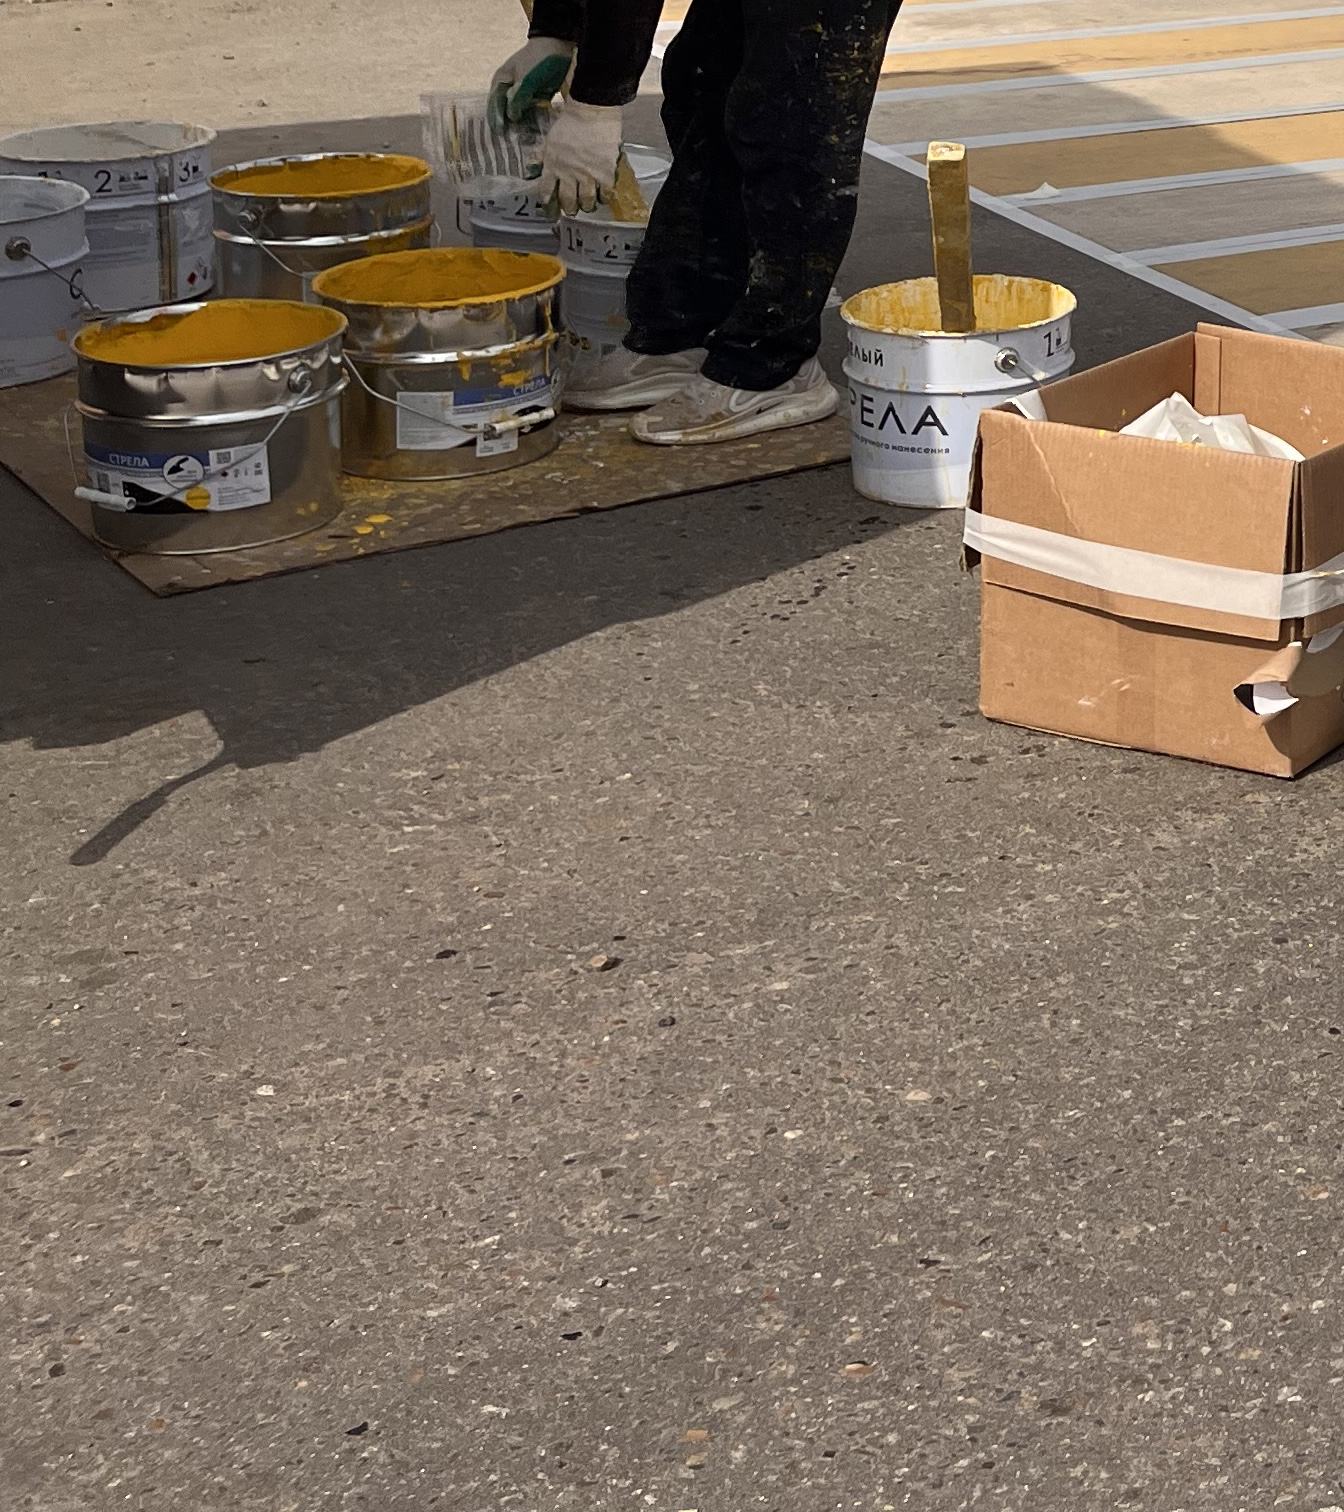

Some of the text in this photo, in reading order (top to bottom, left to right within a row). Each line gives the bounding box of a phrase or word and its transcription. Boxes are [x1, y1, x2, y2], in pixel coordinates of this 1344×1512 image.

[94, 169, 114, 194] 2
[891, 444, 950, 455] нанесения
[108, 452, 150, 468] СТРЕЛА
